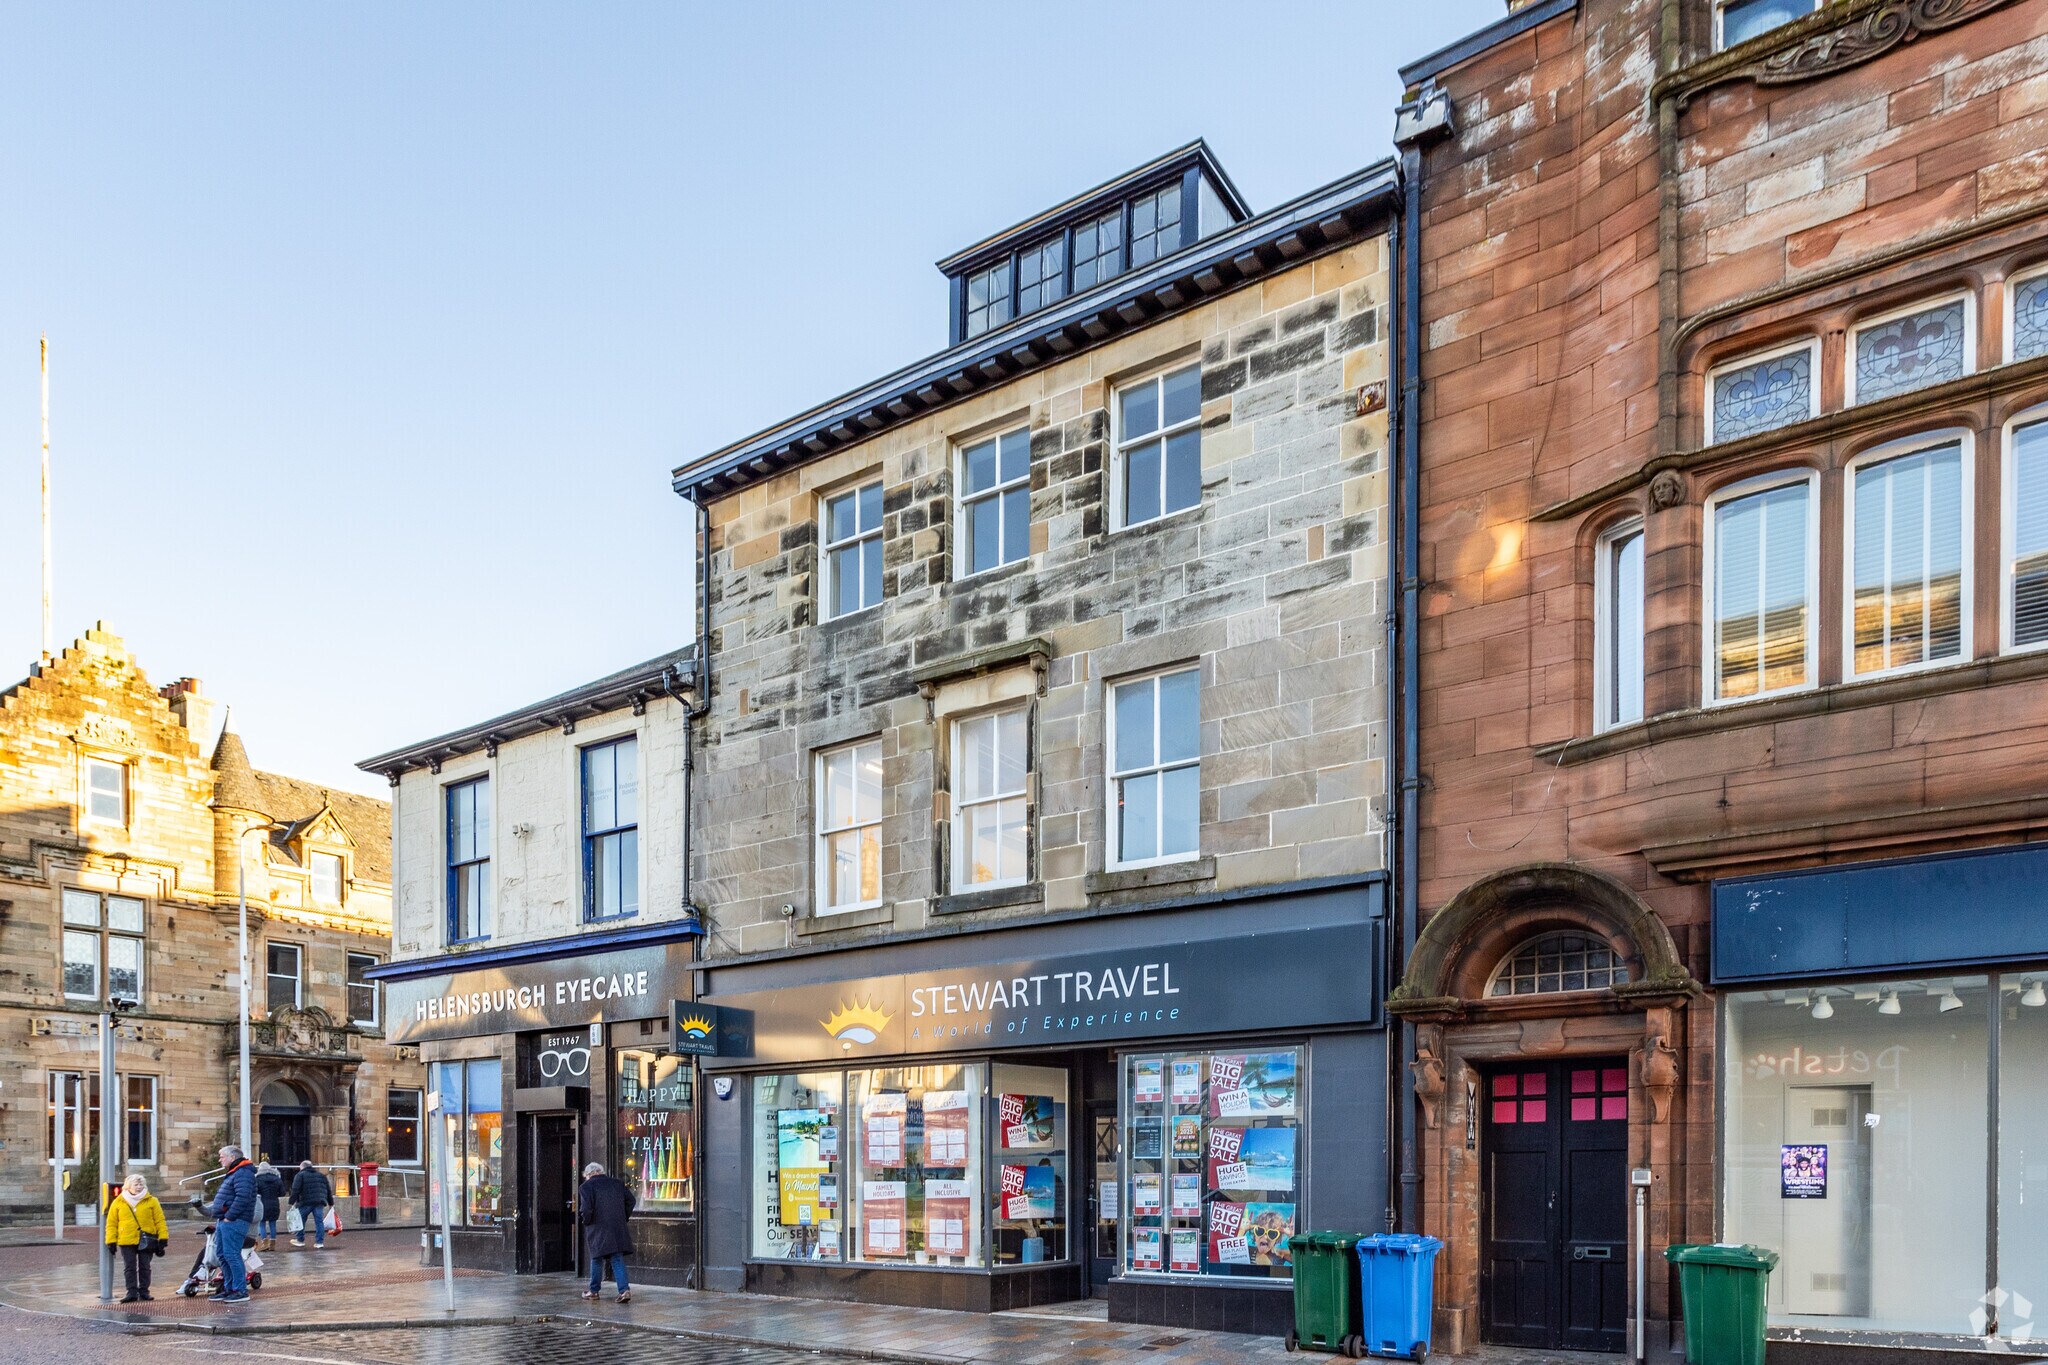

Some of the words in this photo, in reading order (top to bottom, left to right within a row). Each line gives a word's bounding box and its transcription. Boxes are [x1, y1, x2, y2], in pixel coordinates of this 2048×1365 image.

[416, 984, 546, 1021] HELENSBURGH
[555, 971, 649, 1005] EYECARE
[911, 975, 1049, 1017] STEWART
[1053, 962, 1180, 1002] TRAVEL
[911, 1026, 921, 1040] A
[933, 1020, 993, 1039] World
[1007, 1016, 1029, 1034] of
[1043, 1007, 1180, 1030] Experience
[548, 1037, 561, 1047] EST
[561, 1035, 581, 1046] 1967
[1213, 1063, 1240, 1078] BIG
[1211, 1075, 1237, 1091] SALE
[628, 1086, 679, 1104] HAPPY
[1219, 1093, 1239, 1103] WIN
[1003, 1100, 1022, 1114] BIG
[1220, 1098, 1248, 1109] HOLIDAY
[636, 1111, 669, 1127] NEW
[1001, 1111, 1020, 1125] SALE
[1008, 1127, 1022, 1135] WIN
[1224, 1131, 1242, 1139] GREAT
[630, 1136, 676, 1151] YEAR
[1212, 1135, 1238, 1151] BIG
[1209, 1147, 1236, 1164] SALE
[1218, 1164, 1245, 1175] HUGE
[1004, 1171, 1023, 1185] BIG
[872, 1190, 896, 1198] HOLIDAYS
[934, 1189, 961, 1197] INCLUSIVE
[1001, 1183, 1021, 1196] SALE
[1008, 1197, 1027, 1207] HUGE
[1225, 1204, 1243, 1213] GREAT
[767, 1217, 781, 1228] PR
[1213, 1209, 1240, 1225] BIG
[766, 1228, 787, 1241] Our
[789, 1228, 817, 1240] SERV
[1209, 1221, 1237, 1237] SALE
[1220, 1238, 1246, 1250] FREE
